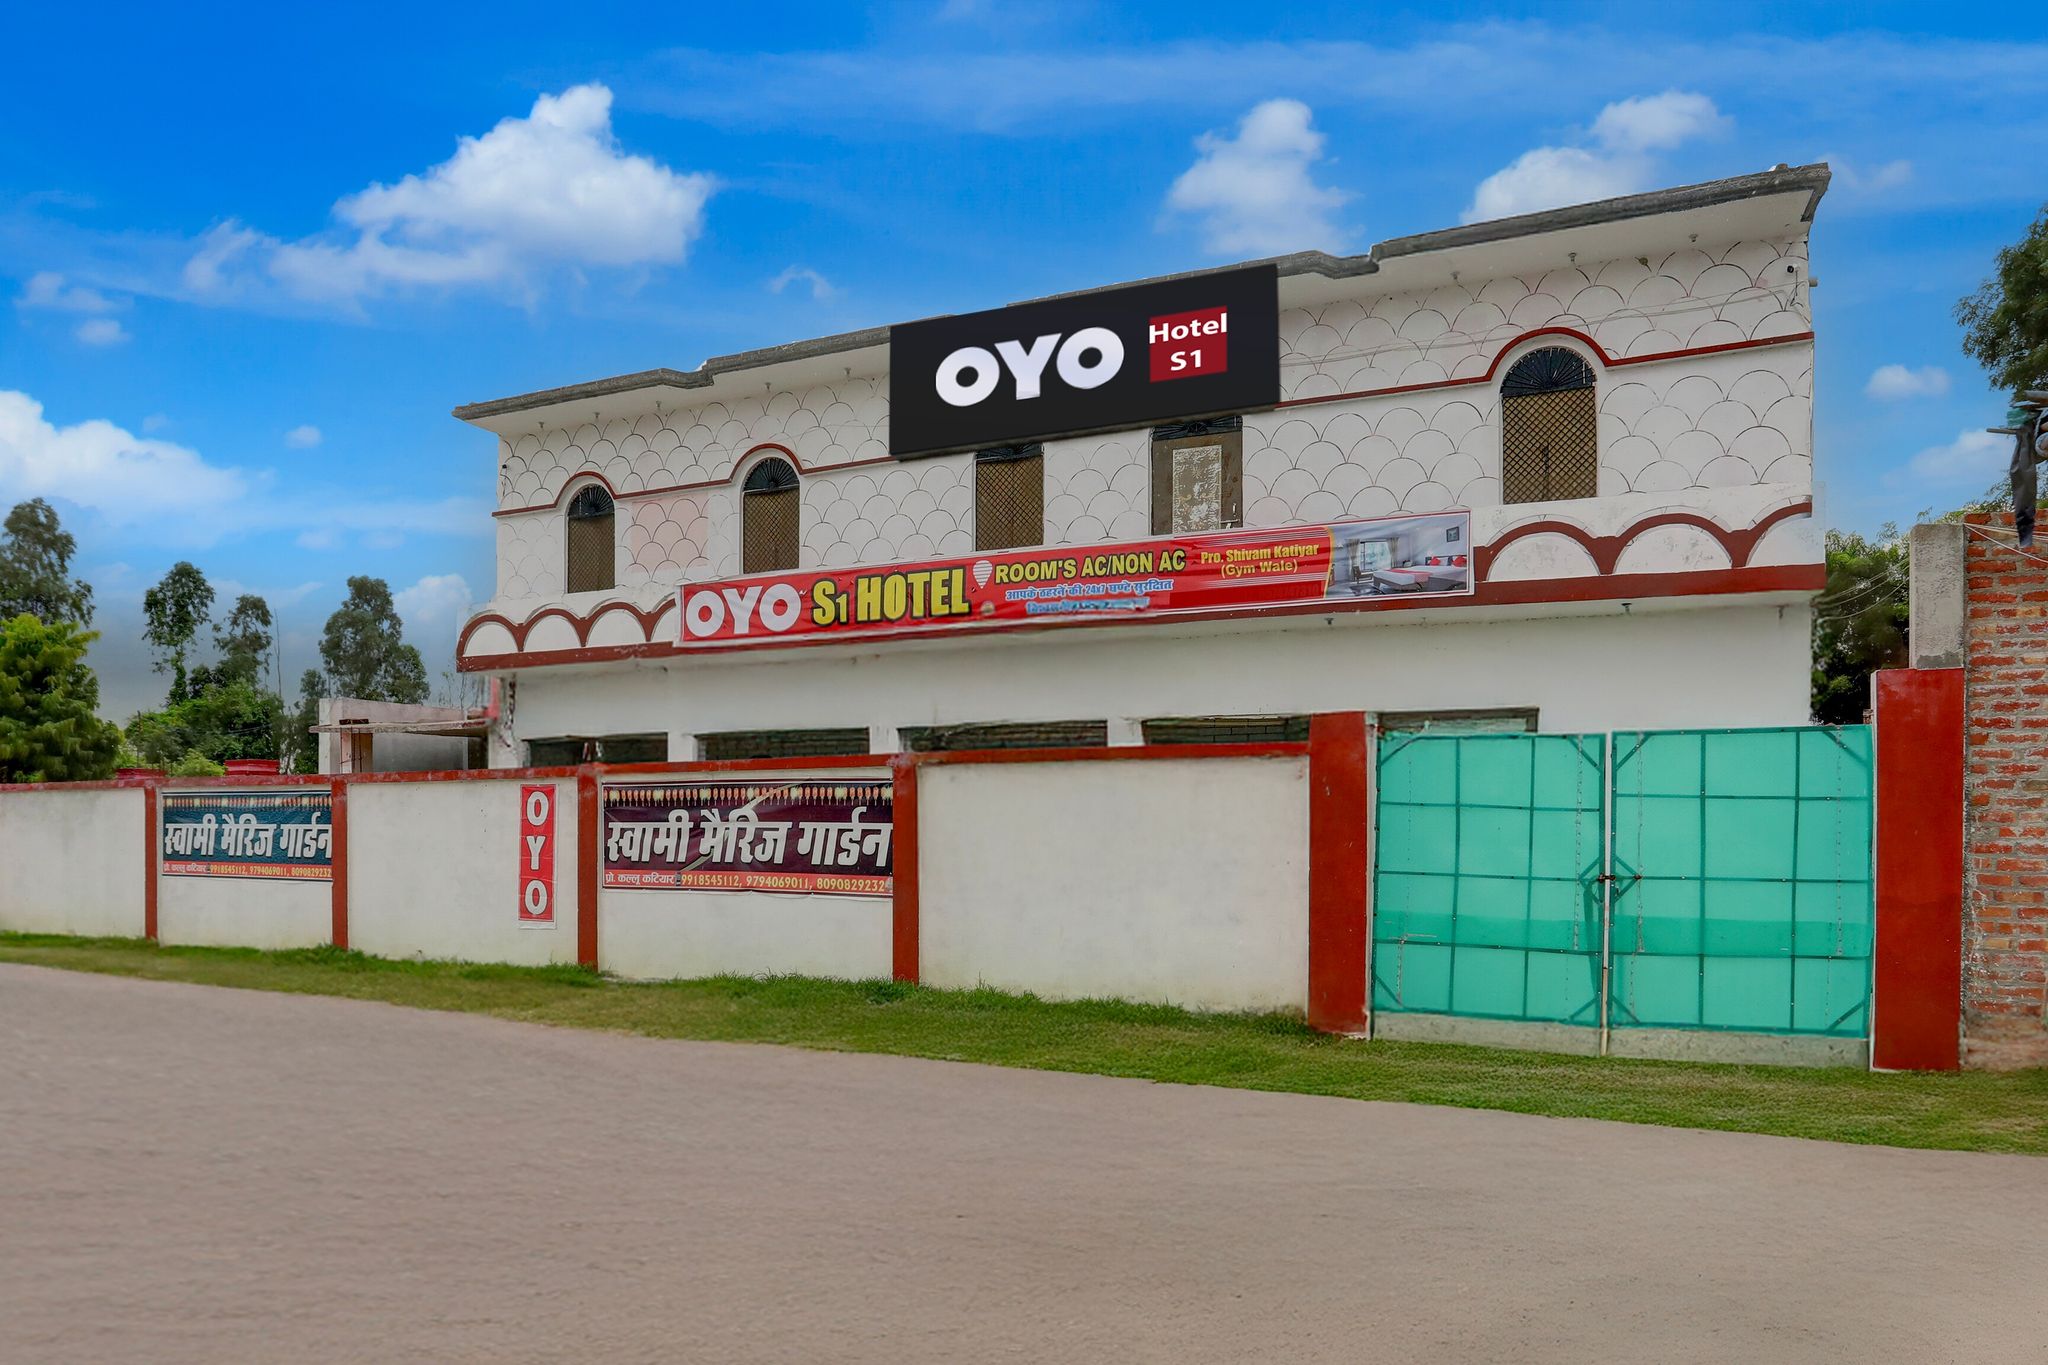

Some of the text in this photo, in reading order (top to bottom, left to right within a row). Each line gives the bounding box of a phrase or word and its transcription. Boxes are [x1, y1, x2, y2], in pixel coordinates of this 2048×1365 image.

[1148, 312, 1228, 344] Hotel
[935, 326, 1125, 407] OYO
[1169, 348, 1202, 371] S1
[994, 549, 1187, 584] ROOM'S AC/NON AC
[1200, 544, 1320, 564] Pro. Shivam Katiyar
[1221, 559, 1298, 579] (Gym Wale)
[811, 567, 971, 627] S1 HOTEL
[1006, 586, 1037, 600] आपके
[1068, 583, 1083, 596] की
[1133, 578, 1174, 596] सुरक्षित
[685, 582, 802, 638] OYO
[165, 812, 332, 858] स्वामी मैरिज गार्डन
[524, 790, 549, 915] OYO
[607, 806, 893, 867] स्वामी मैरिज गार्डन
[618, 874, 641, 885] कल्लू
[642, 872, 676, 885] कटियार
[681, 874, 742, 888] 9918545112,
[746, 875, 813, 891] 9794069011,
[816, 877, 885, 892] 8090829232
